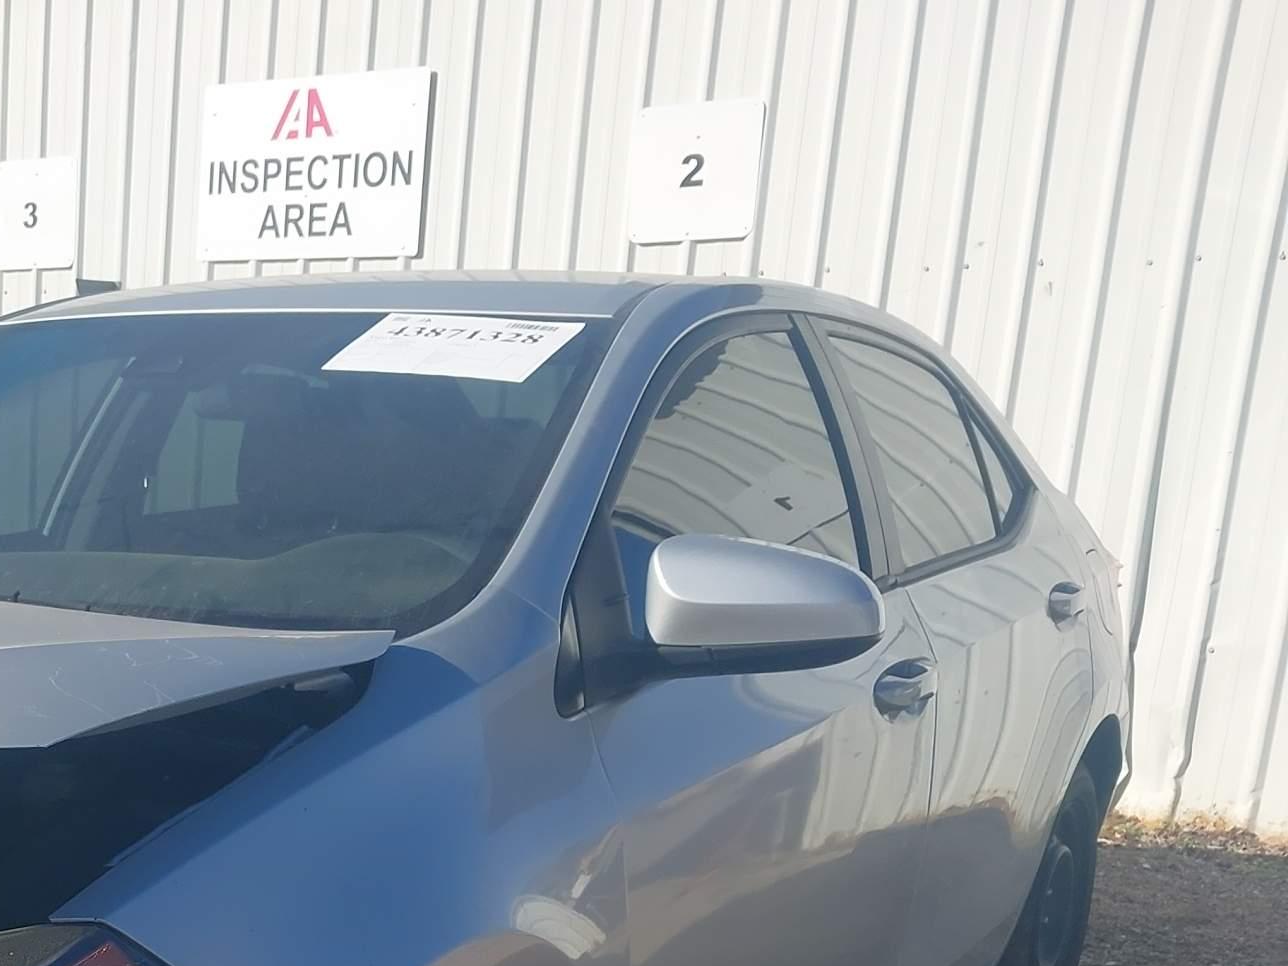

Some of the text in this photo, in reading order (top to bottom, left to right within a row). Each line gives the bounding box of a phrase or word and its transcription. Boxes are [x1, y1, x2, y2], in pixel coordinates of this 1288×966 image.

[209, 150, 414, 195] INSPECTION
[679, 153, 705, 188] 2
[23, 201, 39, 229] 3
[258, 202, 353, 239] AREA
[387, 325, 545, 344] 43871328
